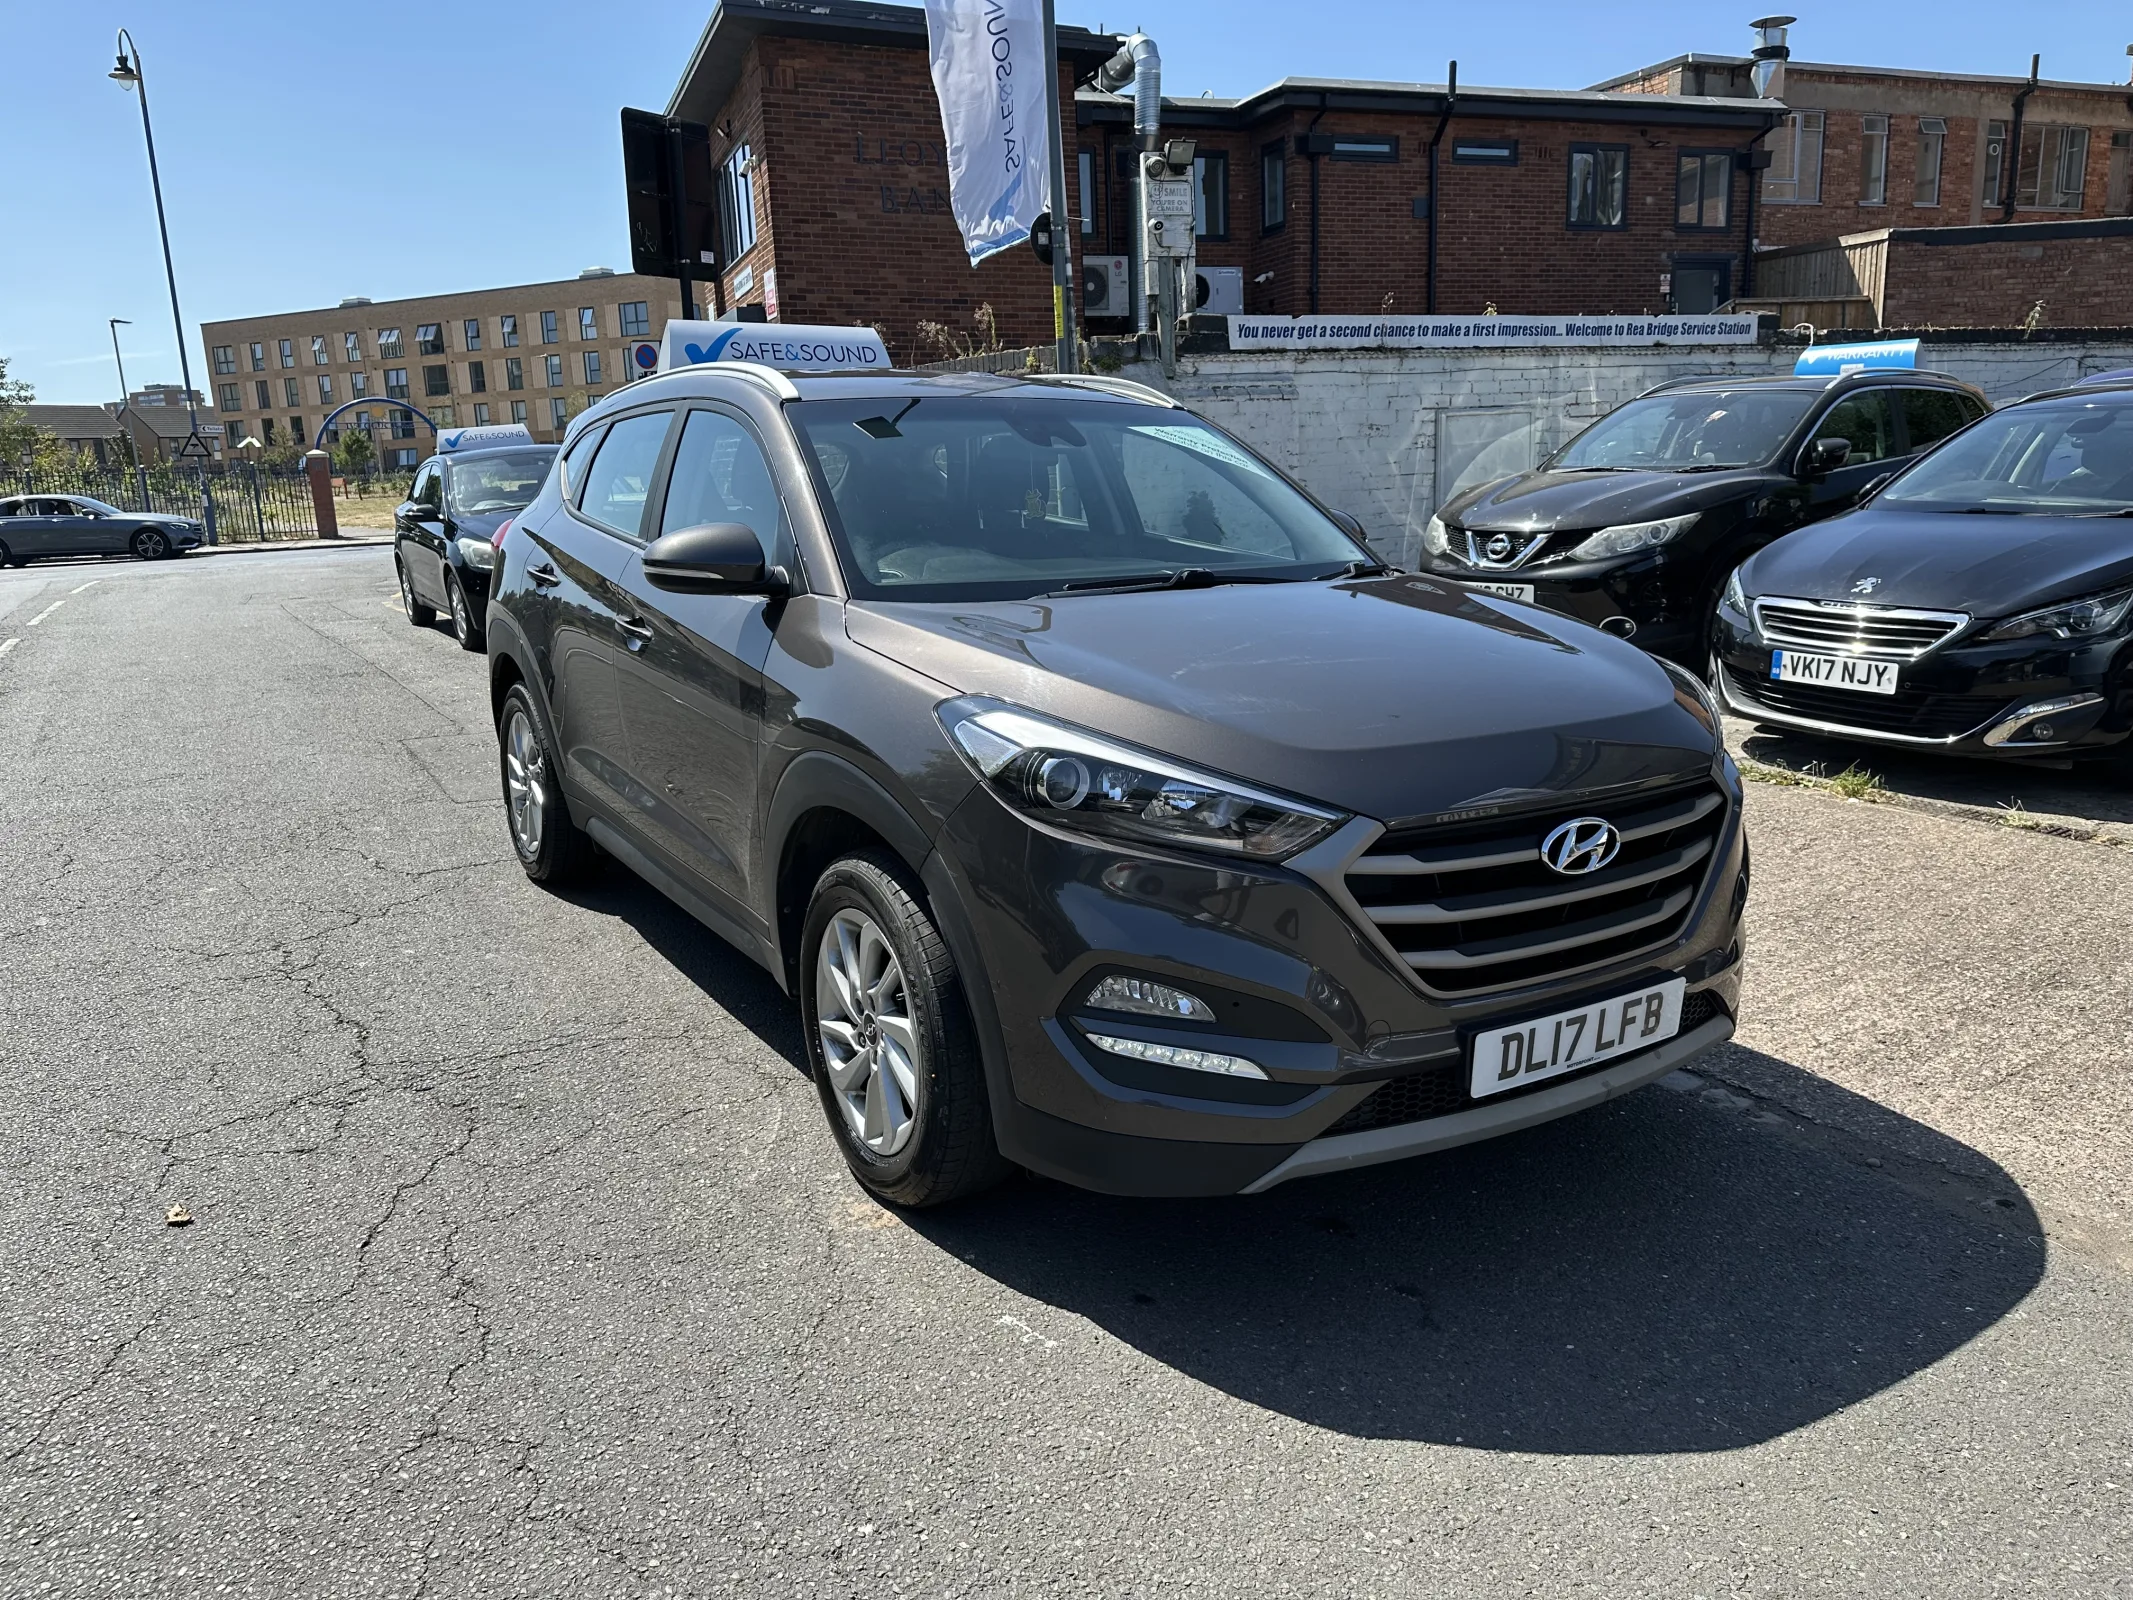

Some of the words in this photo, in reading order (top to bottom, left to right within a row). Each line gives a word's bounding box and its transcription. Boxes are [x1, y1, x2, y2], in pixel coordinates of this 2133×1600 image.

[1164, 187, 1188, 197] SMILE
[1238, 323, 1258, 338] You
[1261, 324, 1295, 338] never
[1297, 325, 1318, 339] get
[1320, 326, 1327, 338] a
[1329, 323, 1371, 338] second
[1373, 323, 1415, 337] chance
[1417, 324, 1430, 337] to
[1431, 323, 1461, 337] make
[1463, 326, 1470, 337] a
[1472, 323, 1496, 337] first
[1497, 323, 1563, 337] impression...
[1565, 322, 1612, 336] Welcome
[1615, 324, 1625, 336] to
[1626, 323, 1644, 336] Rea
[1646, 322, 1680, 337] Bridge
[1681, 322, 1716, 335] Service
[1717, 322, 1751, 335] Station
[730, 341, 877, 364] SAFE&SOUND
[463, 430, 525, 442] SAFE&SOUND
[1154, 427, 1198, 445] Warranty
[1790, 654, 1836, 680] VK17
[1841, 660, 1889, 687] NJY
[1498, 1013, 1588, 1082] DL17
[1595, 991, 1664, 1053] LFB
